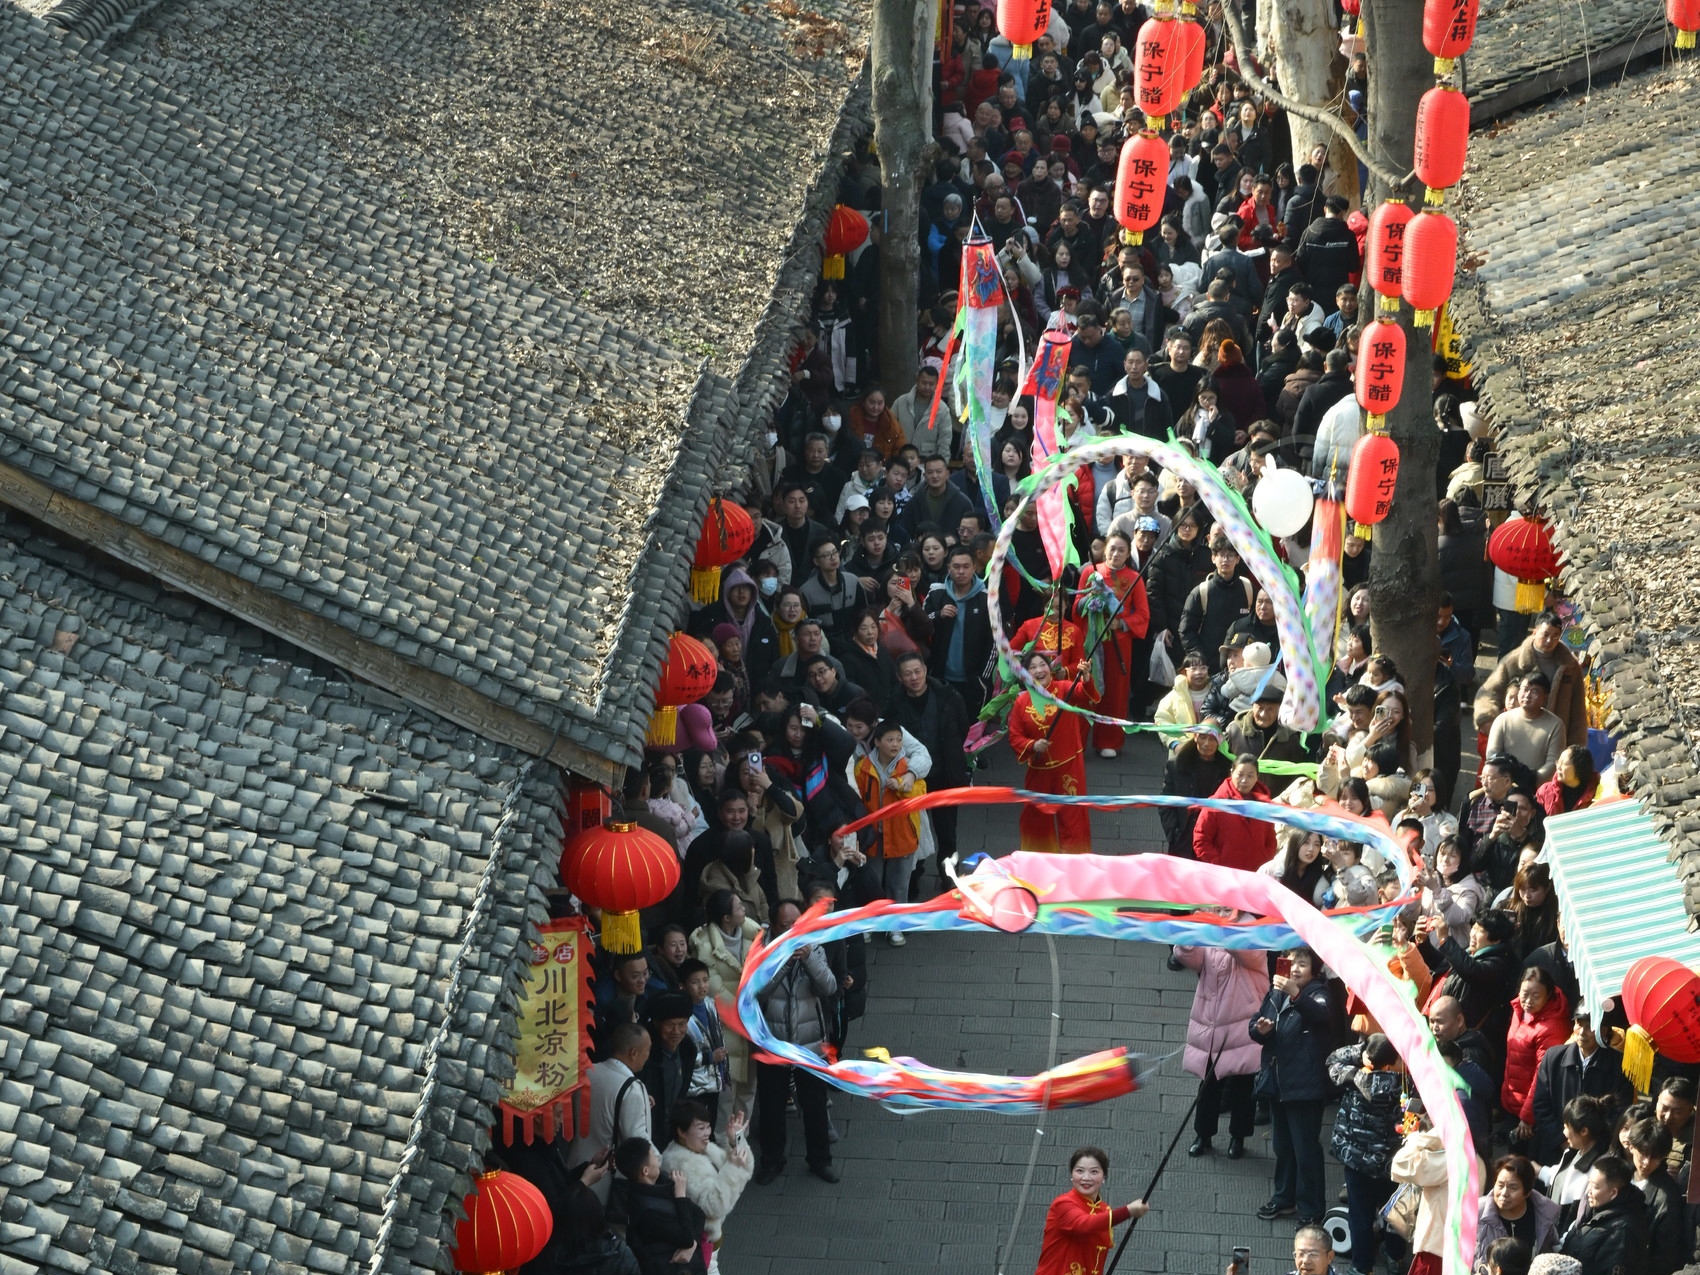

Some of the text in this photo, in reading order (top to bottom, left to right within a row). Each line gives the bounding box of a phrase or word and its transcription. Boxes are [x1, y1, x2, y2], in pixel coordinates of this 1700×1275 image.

[1139, 40, 1165, 105] 保宁醋
[1126, 158, 1158, 221] 保宁醋
[1368, 341, 1396, 402] 保宁醋
[1375, 458, 1398, 517] 保宁醋
[534, 966, 570, 1088] 川北凉粉
